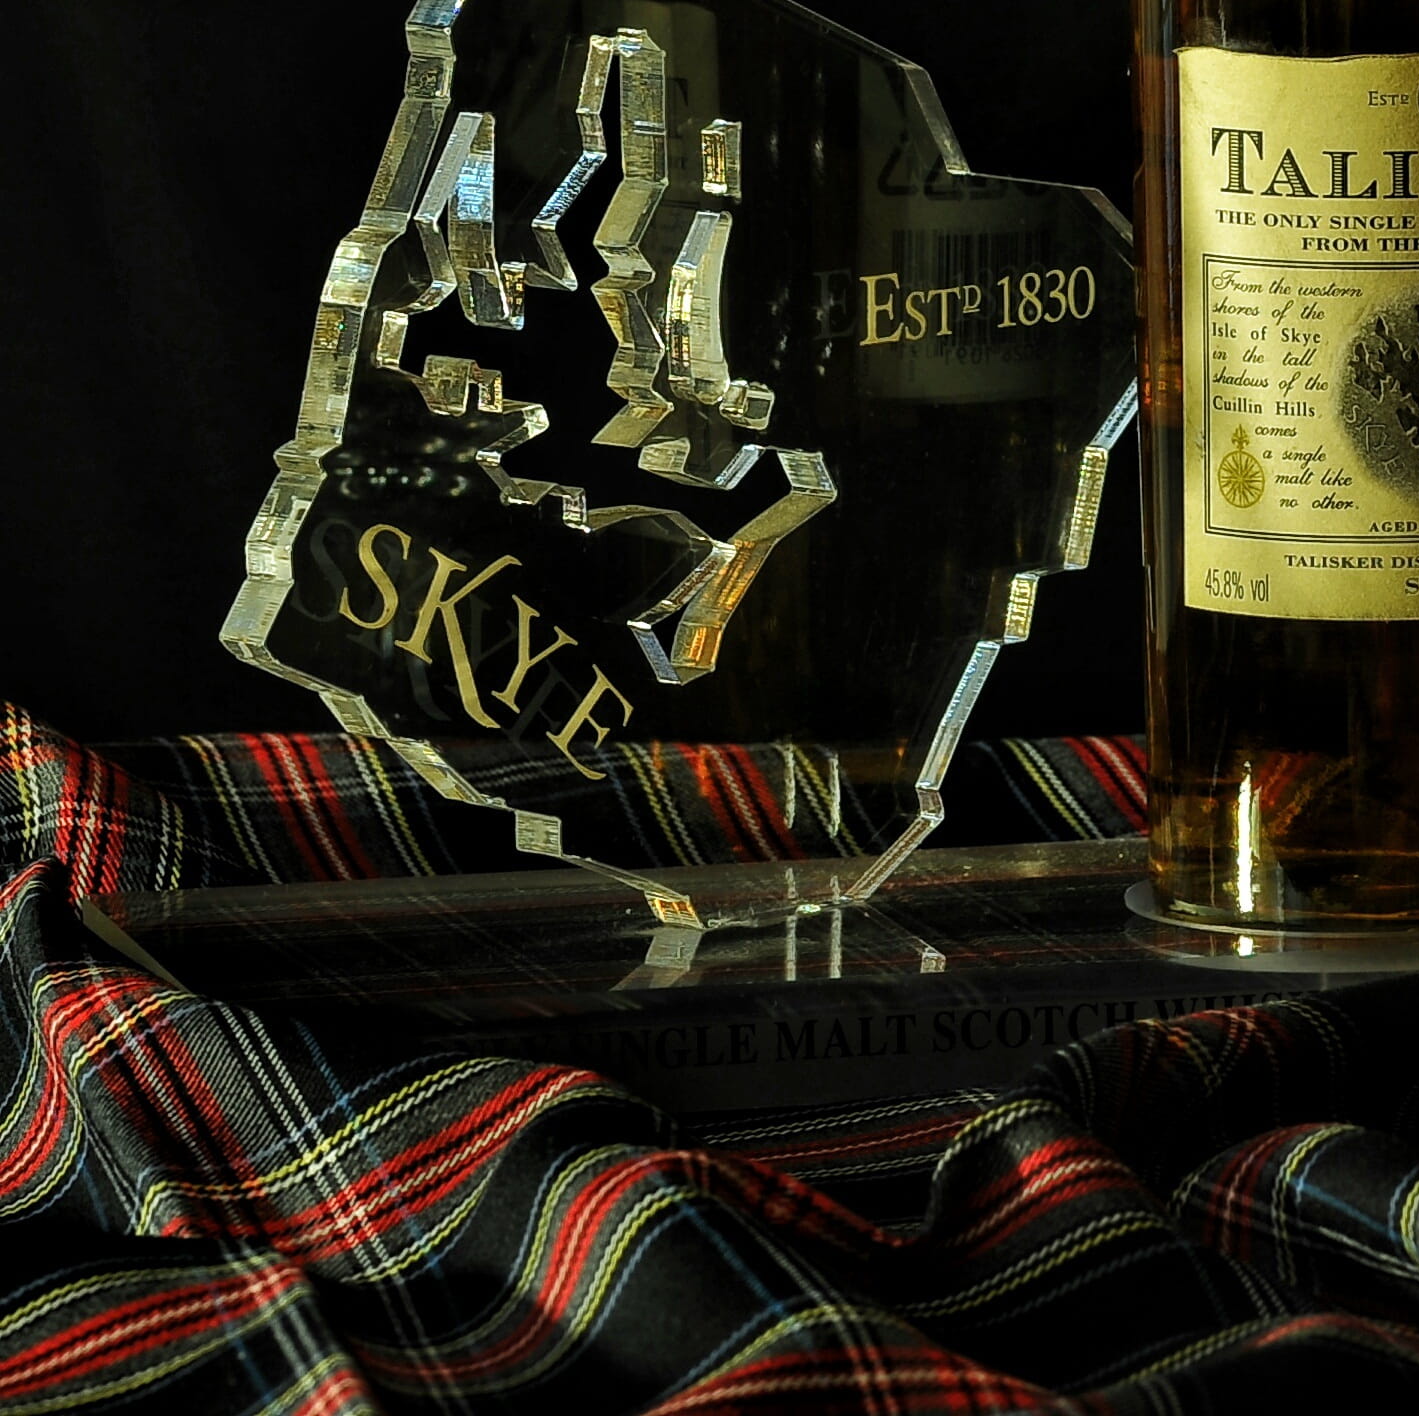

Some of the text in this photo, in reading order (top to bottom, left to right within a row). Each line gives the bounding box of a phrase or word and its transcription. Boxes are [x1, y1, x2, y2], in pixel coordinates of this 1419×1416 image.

[1215, 209, 1257, 226] THE
[1262, 213, 1322, 229] ONLY
[1329, 215, 1417, 230] SINGLE
[1301, 237, 1369, 252] FROM
[1211, 269, 1364, 298] From the western
[996, 265, 1097, 329] 1830
[1212, 296, 1326, 326] shores of the
[1211, 322, 1238, 339] Isle
[1250, 325, 1268, 341] of
[1212, 345, 1317, 367] in the tall
[1212, 366, 1330, 397] shadows of the
[1212, 395, 1263, 415] Cuillin
[1254, 425, 1298, 438] comes
[1262, 444, 1328, 470] a single
[1274, 467, 1353, 487] malt like
[1279, 497, 1299, 509] no
[1368, 521, 1418, 534] AGED
[1284, 554, 1385, 569] TALISKER
[1204, 567, 1270, 603] 45.8% vol
[338, 522, 636, 782] SKYE
[773, 1014, 917, 1063] MALT
[931, 1001, 1138, 1054] SCOTCH
